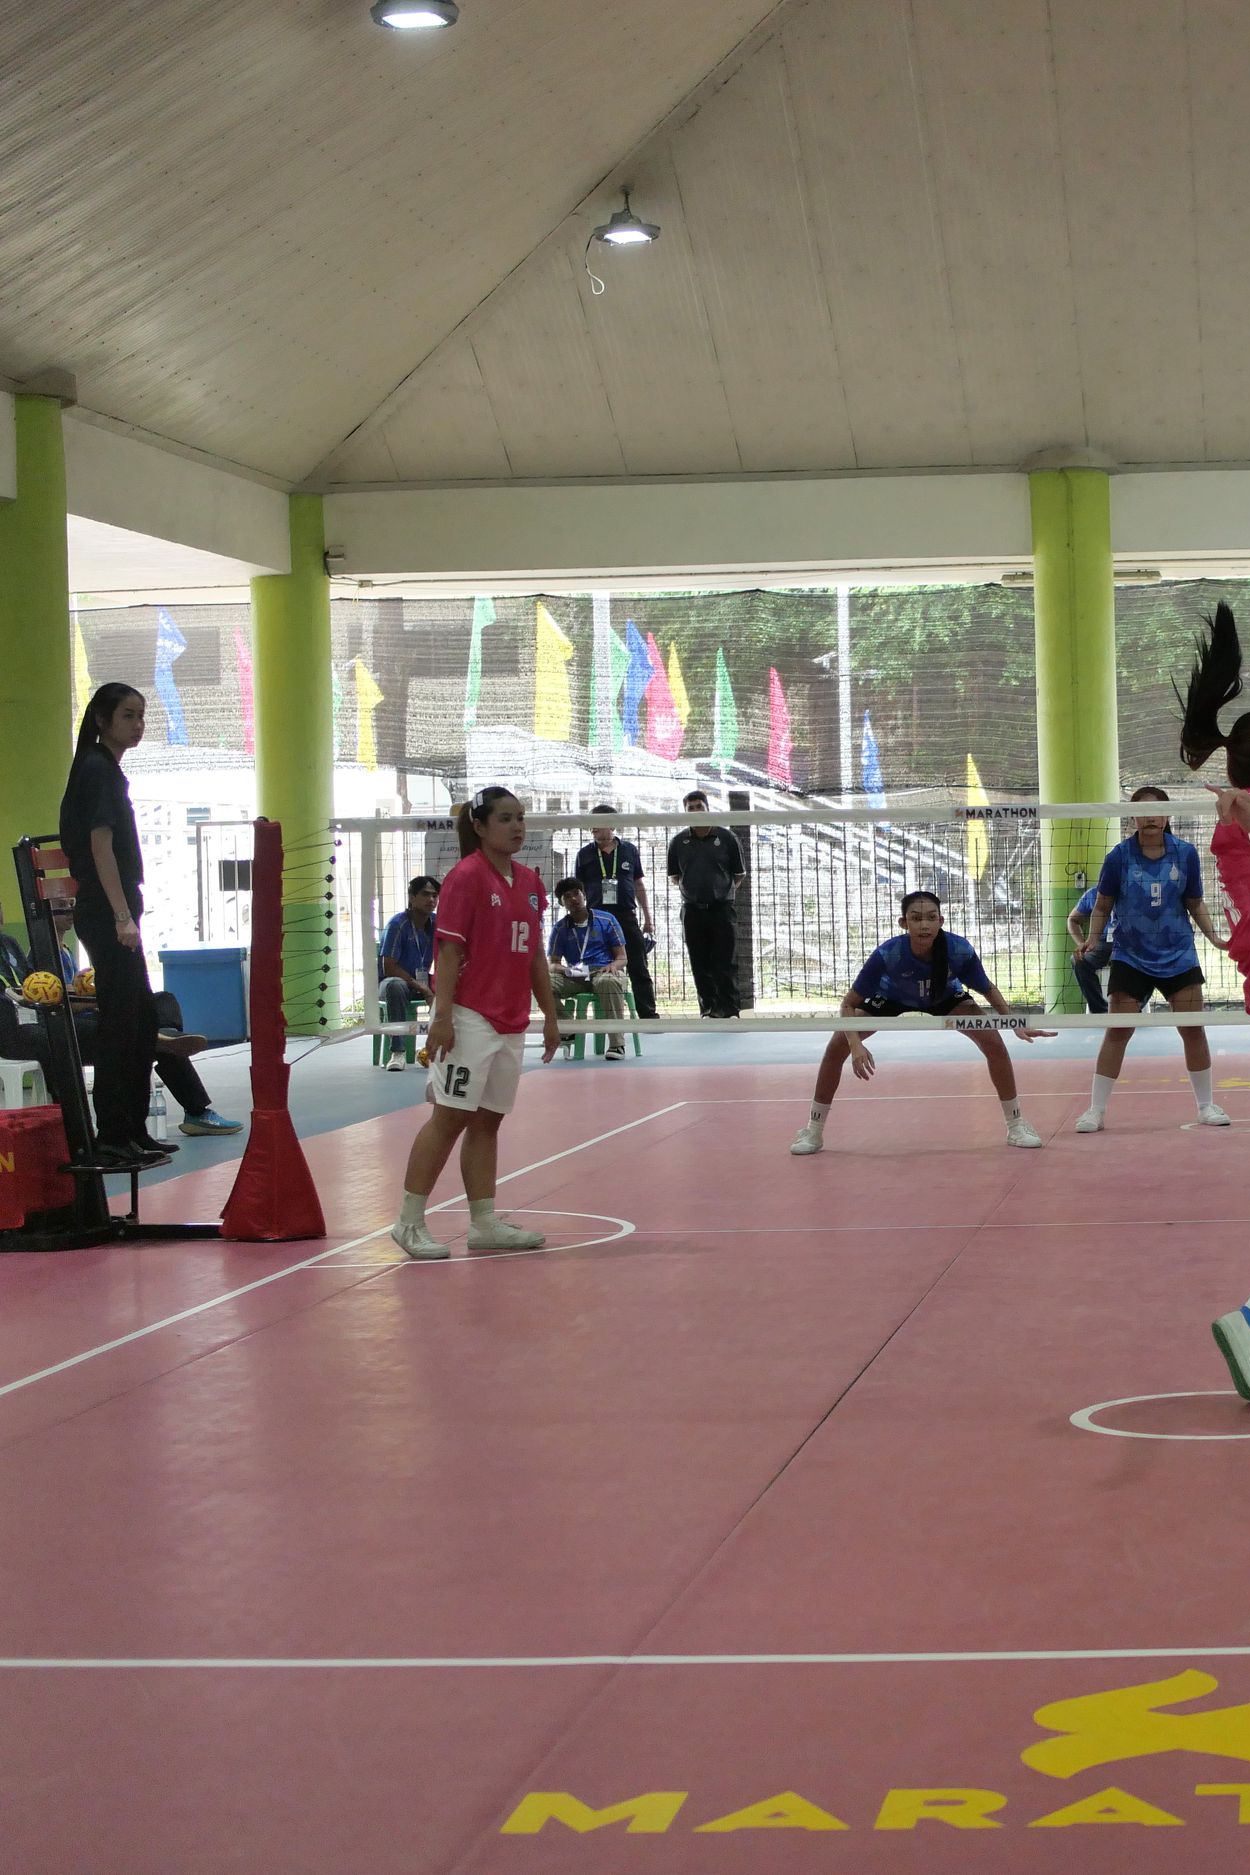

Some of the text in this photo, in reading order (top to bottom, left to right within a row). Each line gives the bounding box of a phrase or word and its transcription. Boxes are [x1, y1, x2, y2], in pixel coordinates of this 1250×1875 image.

[965, 807, 1037, 819] MARATHON
[1150, 883, 1162, 907] 9
[511, 921, 529, 953] 12
[956, 1018, 1027, 1030] MARATHON
[444, 1064, 471, 1098] 12
